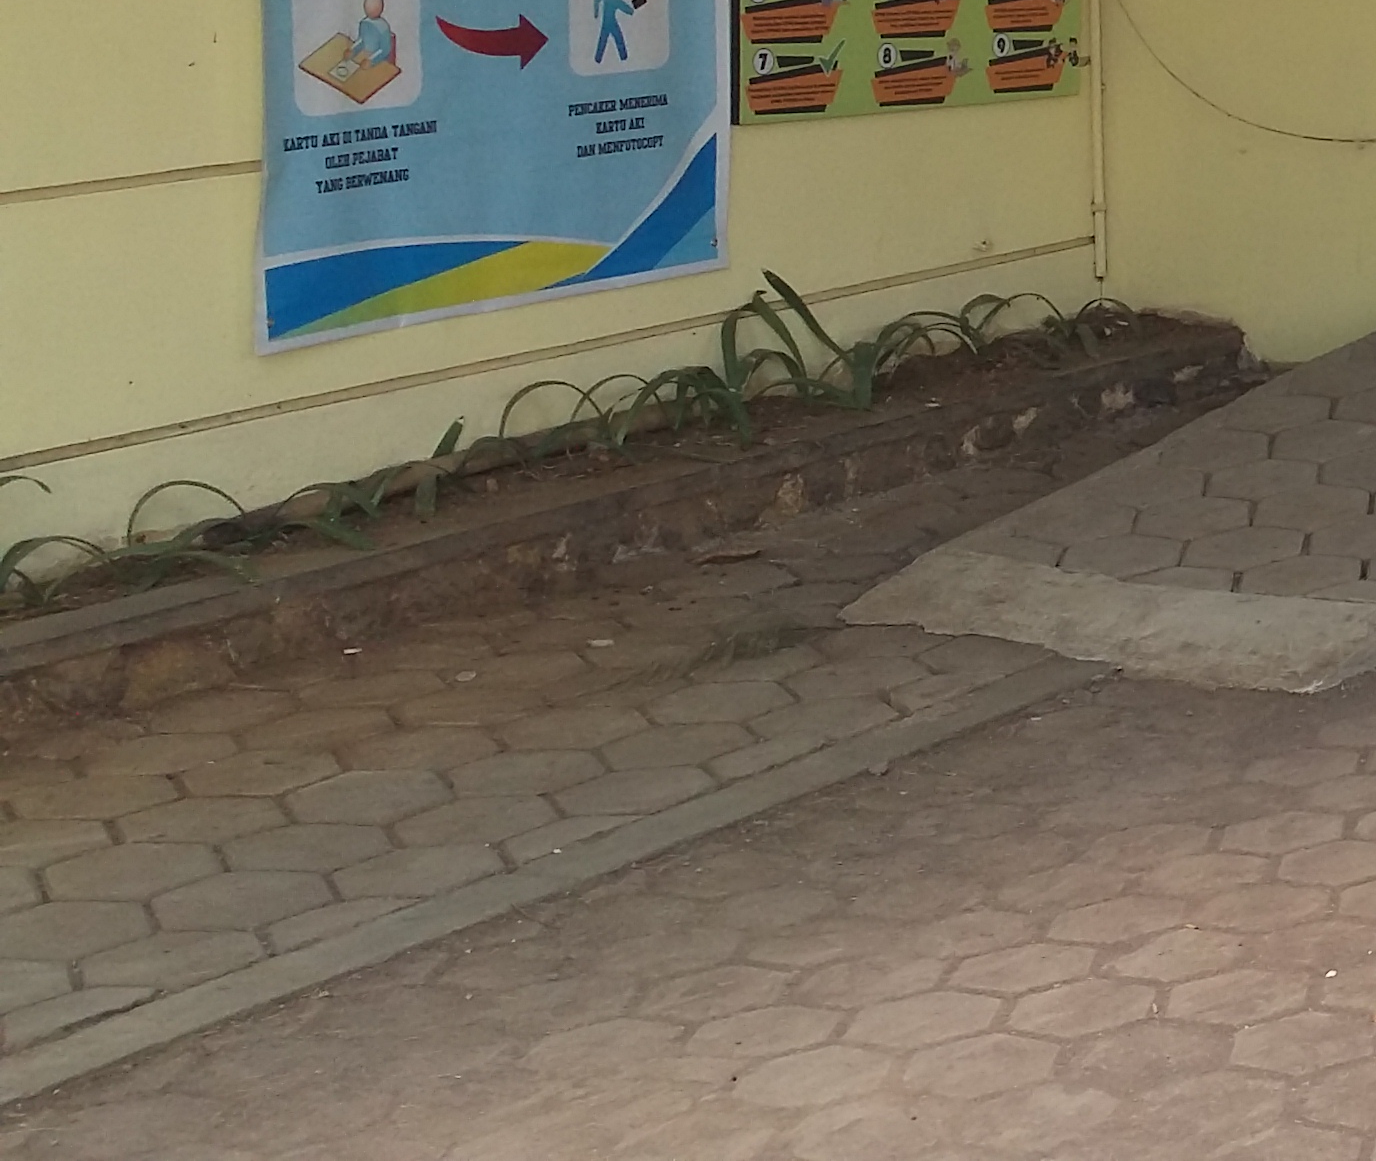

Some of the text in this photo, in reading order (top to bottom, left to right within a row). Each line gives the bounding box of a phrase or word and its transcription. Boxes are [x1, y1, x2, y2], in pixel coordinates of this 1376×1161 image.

[882, 47, 892, 63] 8
[284, 136, 318, 152] KARTU
[353, 126, 388, 142] TANDA
[352, 147, 399, 166] PEJABAT
[315, 168, 409, 194] YANG BERWENANG
